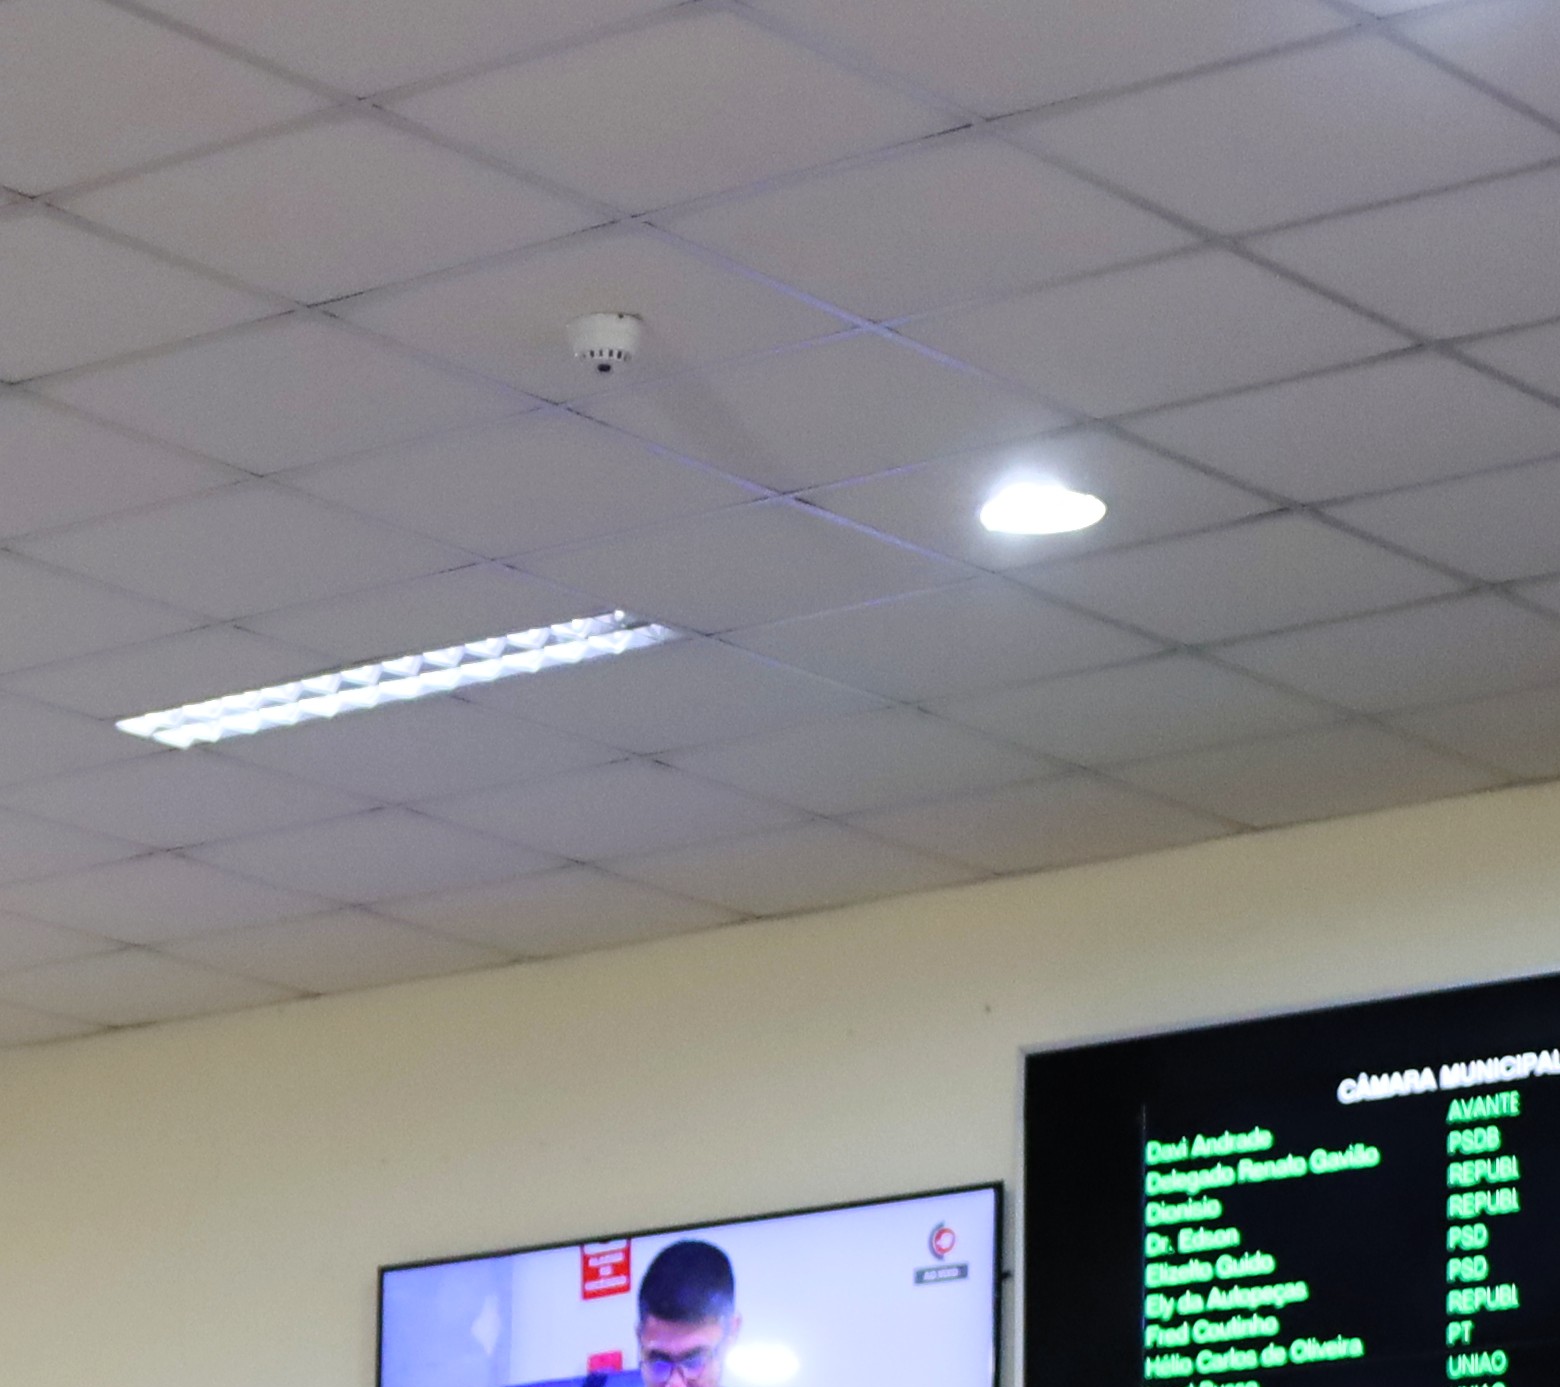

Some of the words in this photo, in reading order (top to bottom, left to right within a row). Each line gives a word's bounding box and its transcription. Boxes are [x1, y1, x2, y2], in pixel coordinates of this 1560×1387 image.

[1337, 1066, 1437, 1104] CÂMARA
[1446, 1090, 1521, 1124] AVANTE
[1145, 1136, 1188, 1165] Davi
[1191, 1126, 1274, 1158] Andrade
[1446, 1125, 1501, 1156] PSDB
[1145, 1162, 1236, 1196] Delegado
[1237, 1153, 1308, 1184] Renato
[1309, 1143, 1380, 1174] Gavião
[1145, 1232, 1175, 1257] Dr.
[1177, 1226, 1240, 1254] Edson
[1446, 1223, 1489, 1252] PSD
[1145, 1258, 1214, 1288] Elizelto
[1215, 1250, 1276, 1280] Guido
[1446, 1255, 1489, 1284] PSD
[1145, 1292, 1175, 1322] Ely
[1176, 1289, 1205, 1316] da
[1206, 1280, 1309, 1311] Autopeças
[1145, 1320, 1188, 1349] Fred
[1192, 1312, 1279, 1345] Coutinho
[1446, 1319, 1474, 1346] PT
[1145, 1351, 1194, 1380] Hélio
[1195, 1345, 1259, 1375] Carlos
[1260, 1342, 1287, 1367] de
[1288, 1333, 1365, 1364] Oliveira
